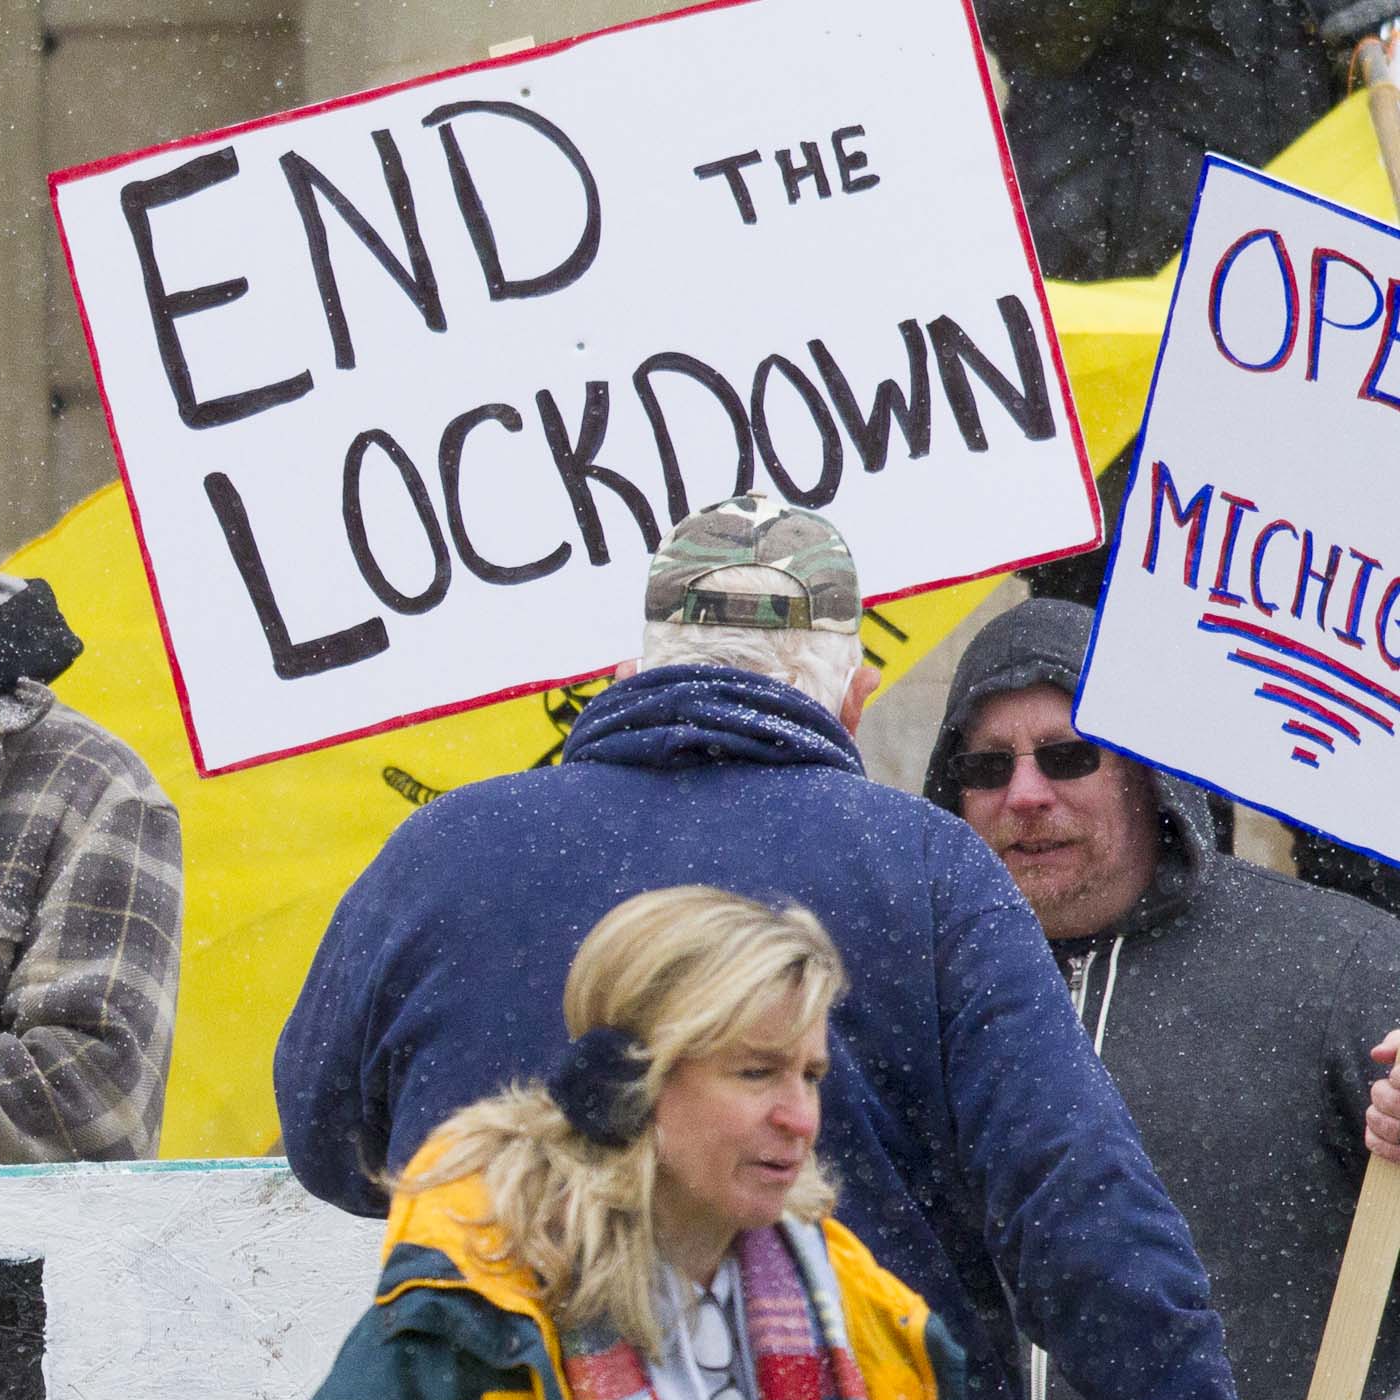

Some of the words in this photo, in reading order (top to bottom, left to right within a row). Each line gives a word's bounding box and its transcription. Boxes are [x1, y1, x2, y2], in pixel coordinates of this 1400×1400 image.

[120, 99, 602, 430] END
[693, 123, 882, 226] THE
[204, 294, 1056, 679] LOCKDOWN
